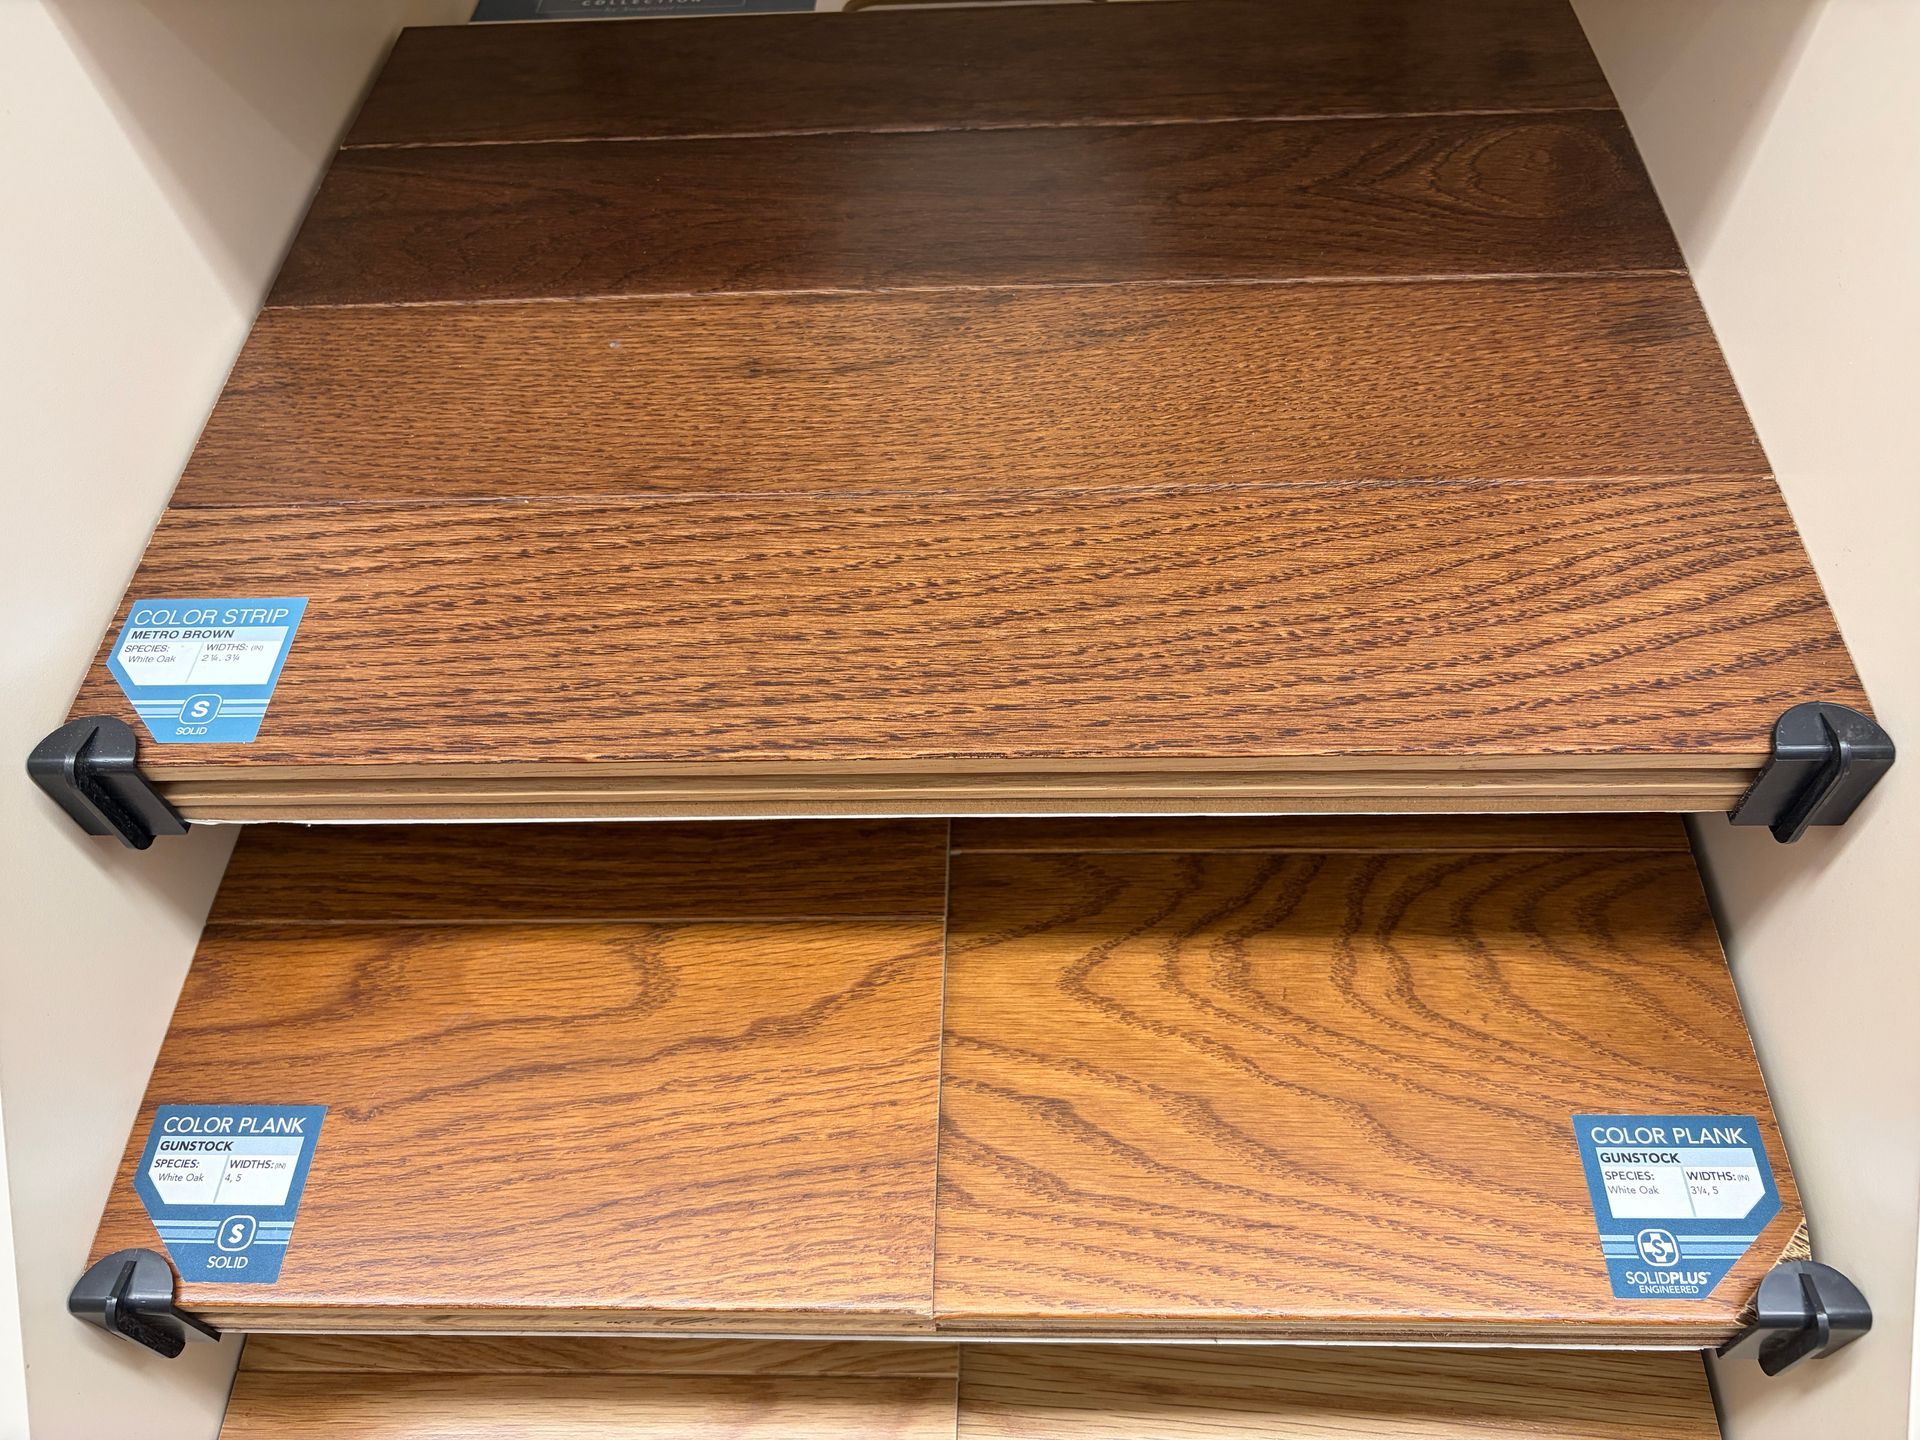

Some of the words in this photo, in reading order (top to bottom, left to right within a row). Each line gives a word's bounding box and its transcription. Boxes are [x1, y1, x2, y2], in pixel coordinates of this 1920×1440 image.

[134, 609, 217, 625] COLOR
[222, 609, 289, 624] STRIP
[131, 631, 179, 639] METRO
[183, 630, 234, 638] BROWN
[125, 645, 171, 653] SPECIES:
[156, 655, 176, 663] Oak
[191, 701, 210, 717] S
[176, 727, 207, 735] SOLID
[164, 1117, 233, 1133] COLOR
[238, 1117, 307, 1133] PLANK
[1591, 1128, 1668, 1144] COLOR
[1673, 1128, 1747, 1144] PLANK
[160, 1141, 234, 1151] GUNSTOCK
[1600, 1153, 1681, 1163] GUNSTOCK
[154, 1159, 200, 1168] SPECIES:
[230, 1160, 274, 1168] WIDTHS:
[159, 1174, 183, 1182] White
[186, 1173, 204, 1182] Oak
[225, 1174, 233, 1183] 4,
[235, 1174, 242, 1182] 5
[1605, 1171, 1655, 1181] SPECIES:
[1686, 1172, 1737, 1181] WIDTHS:
[1608, 1186, 1637, 1194] White
[1639, 1186, 1659, 1194] Oak
[1713, 1186, 1719, 1194] 5
[228, 1224, 245, 1243] S
[206, 1256, 248, 1268] SOLID
